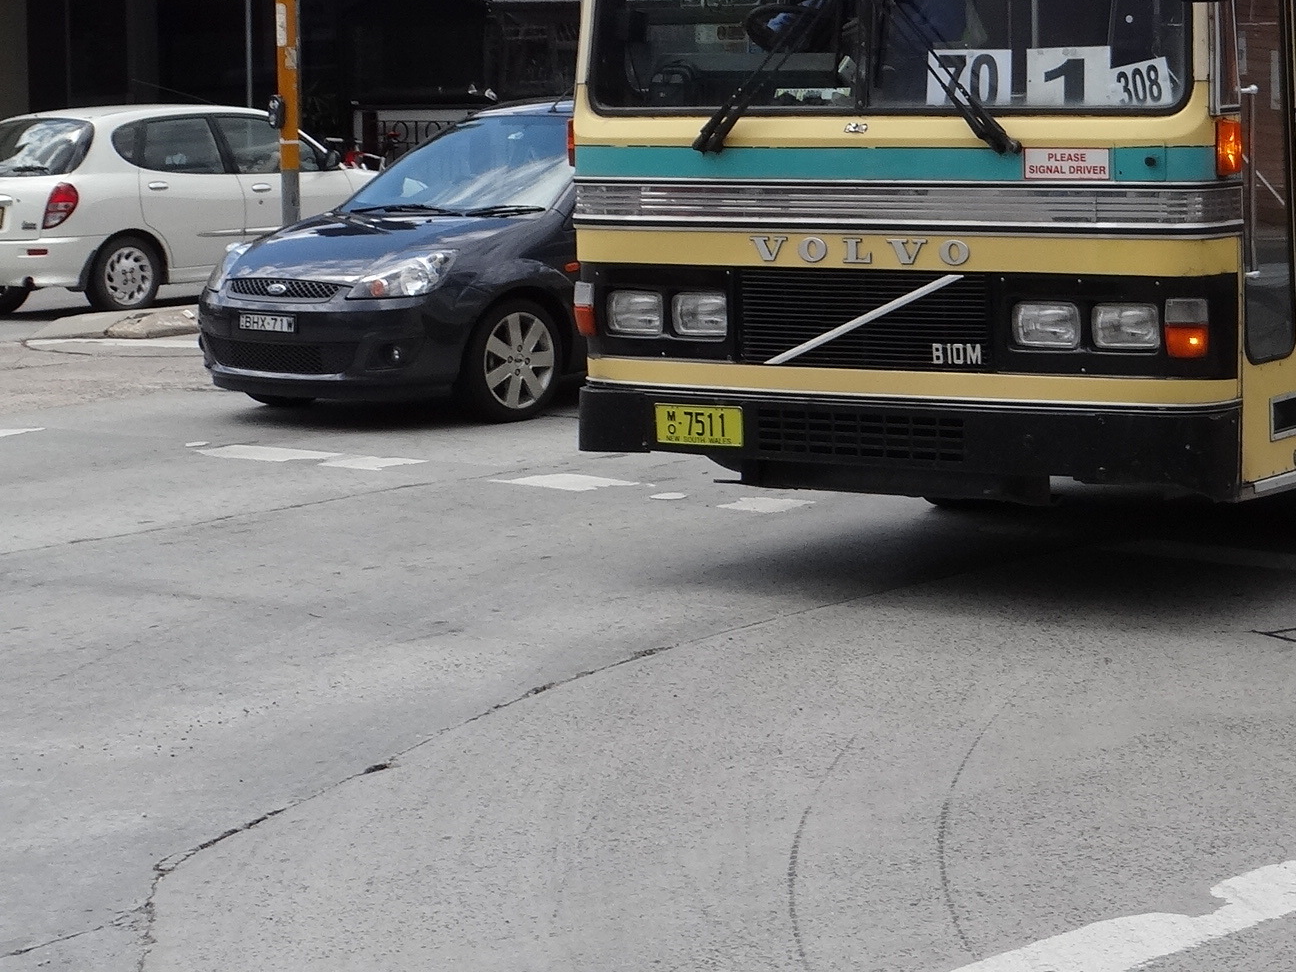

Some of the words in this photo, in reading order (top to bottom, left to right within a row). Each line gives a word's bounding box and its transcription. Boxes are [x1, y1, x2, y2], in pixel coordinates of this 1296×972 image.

[937, 54, 998, 105] 70
[1044, 58, 1085, 105] 1
[1116, 64, 1162, 105] 308
[1029, 165, 1066, 174] SIGNAL
[1069, 165, 1106, 175] DRIVER
[1048, 153, 1086, 162] PLEASE
[750, 236, 970, 266] VOLVO
[932, 343, 982, 365] B10M
[684, 411, 725, 437] 7511
